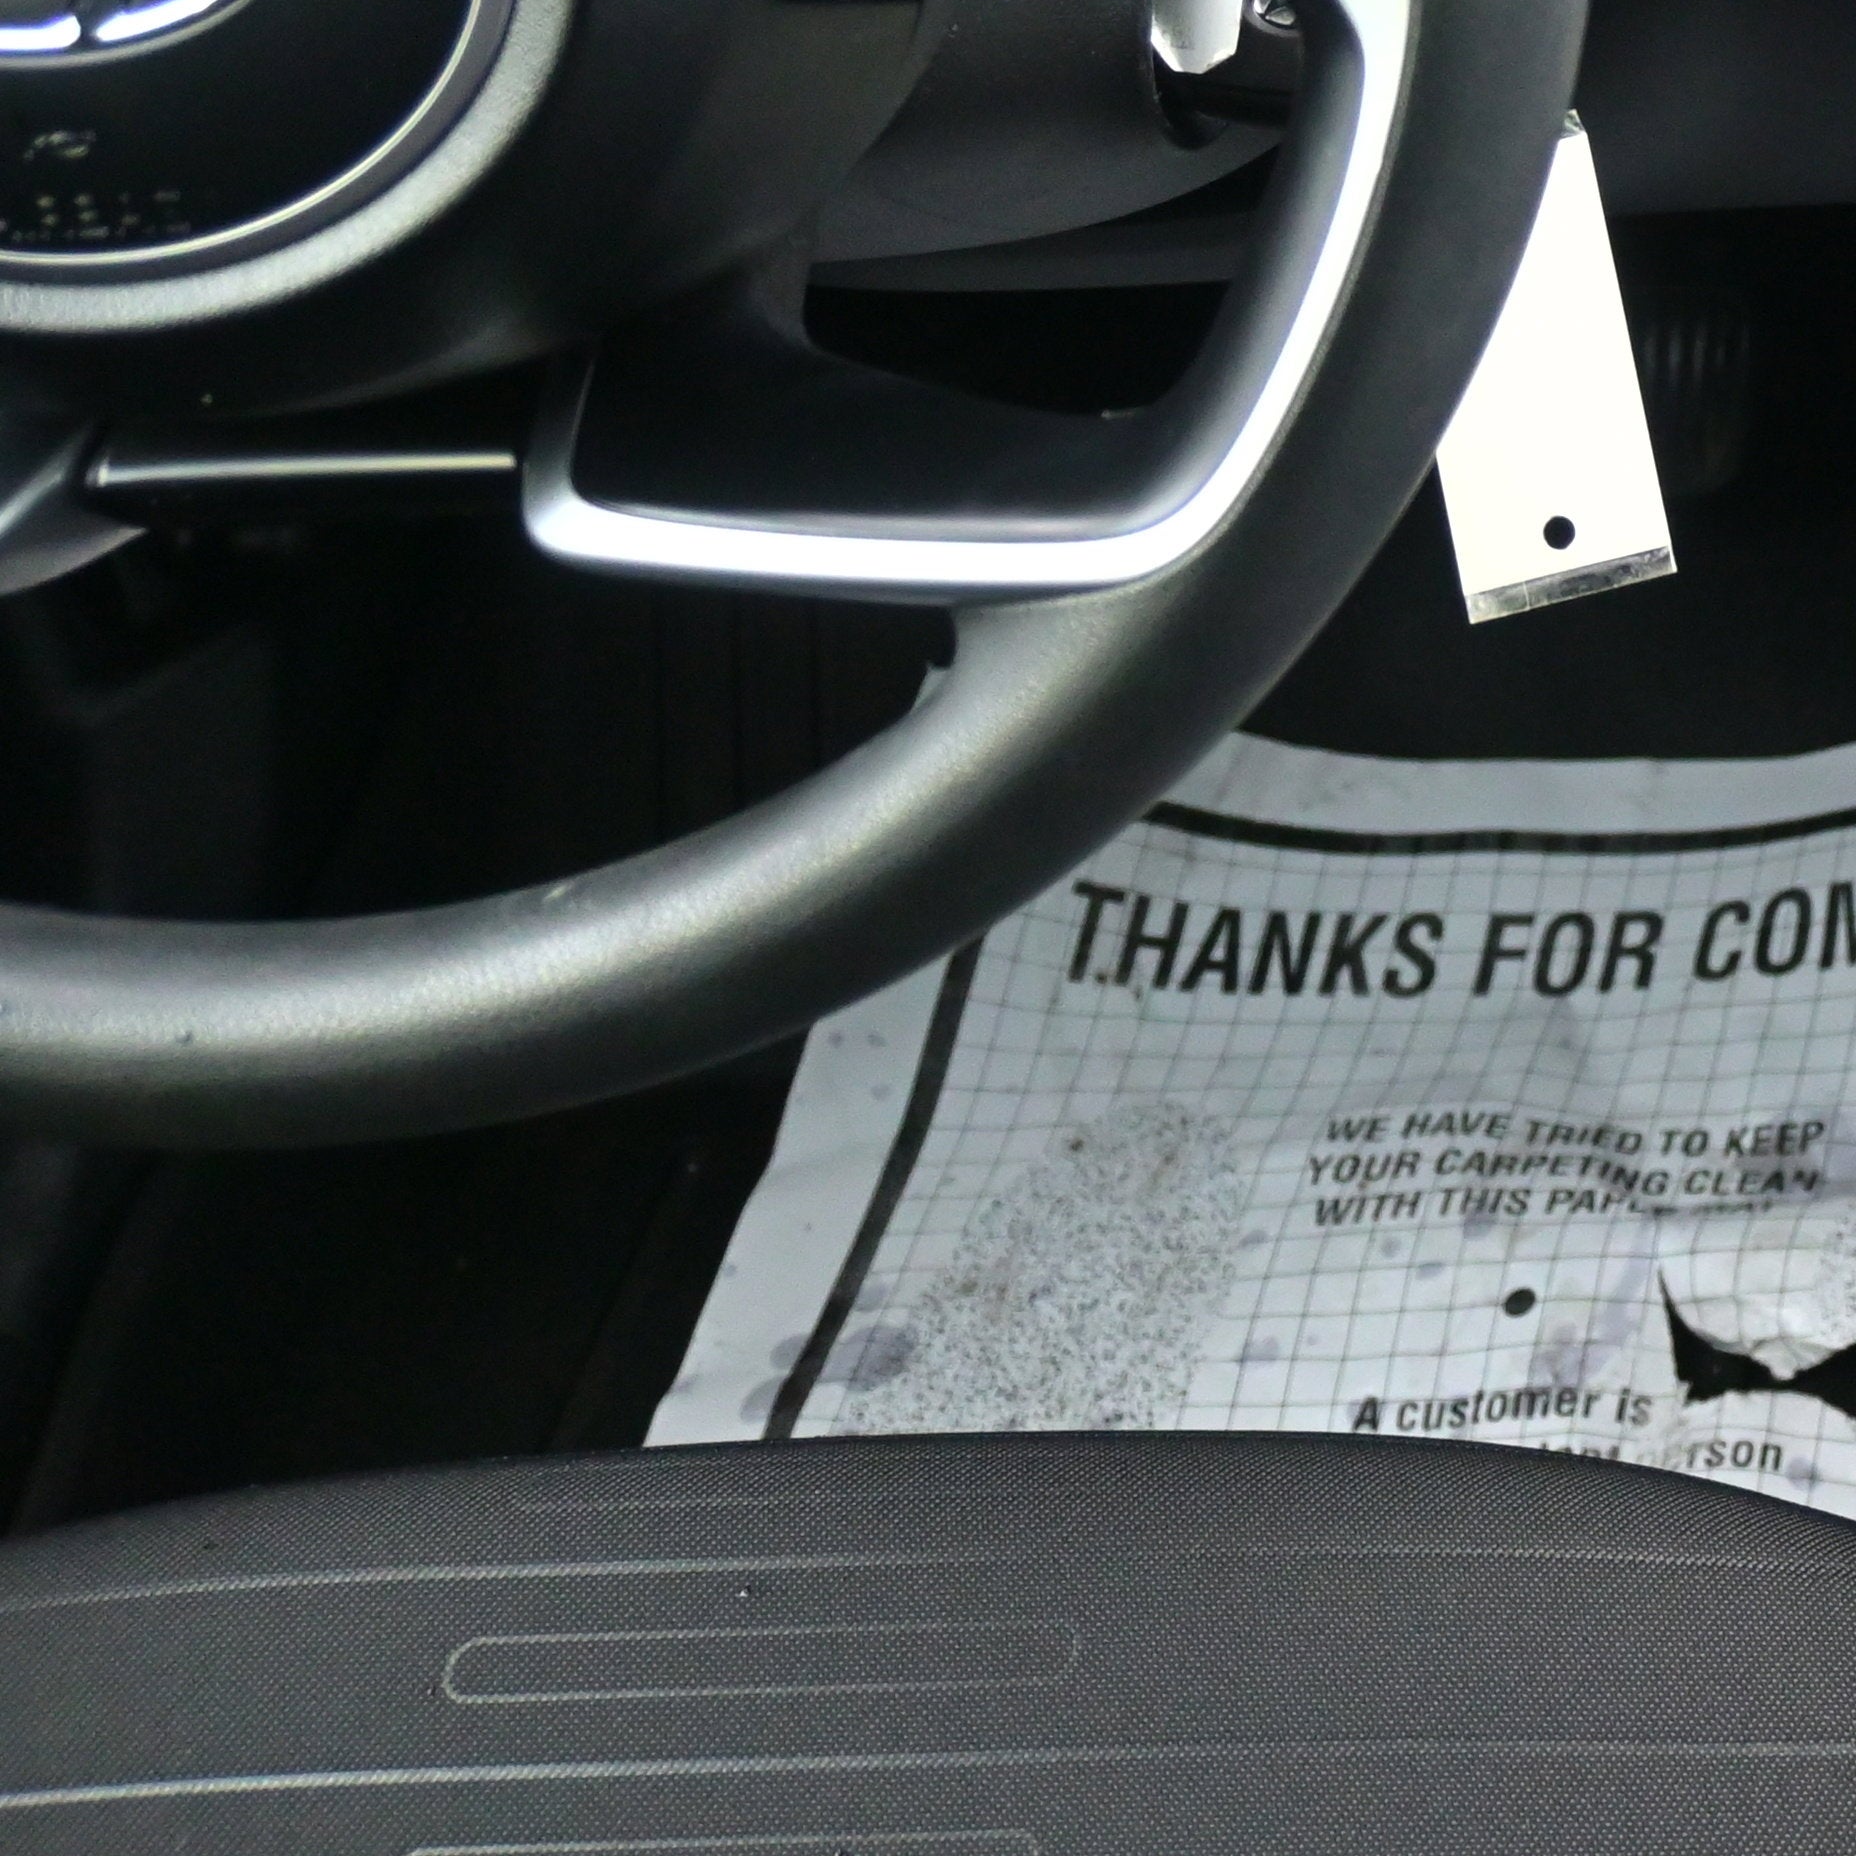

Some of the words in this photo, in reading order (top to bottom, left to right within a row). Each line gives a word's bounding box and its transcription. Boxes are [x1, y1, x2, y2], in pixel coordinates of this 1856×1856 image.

[1068, 881, 1444, 998] THANKS
[1472, 912, 1665, 998] FOR
[1325, 1115, 1391, 1143] WE
[1401, 1111, 1513, 1138] HAVE
[1660, 1130, 1710, 1157] TO
[1728, 1122, 1825, 1157] KEEP
[1307, 1152, 1421, 1184] YOUR
[1434, 1149, 1669, 1196] CARPETING
[1315, 1190, 1421, 1227] WITH
[1438, 1187, 1531, 1217] THIS
[1353, 1397, 1381, 1430] A
[1396, 1390, 1599, 1430] customer
[1614, 1388, 1653, 1426] is
